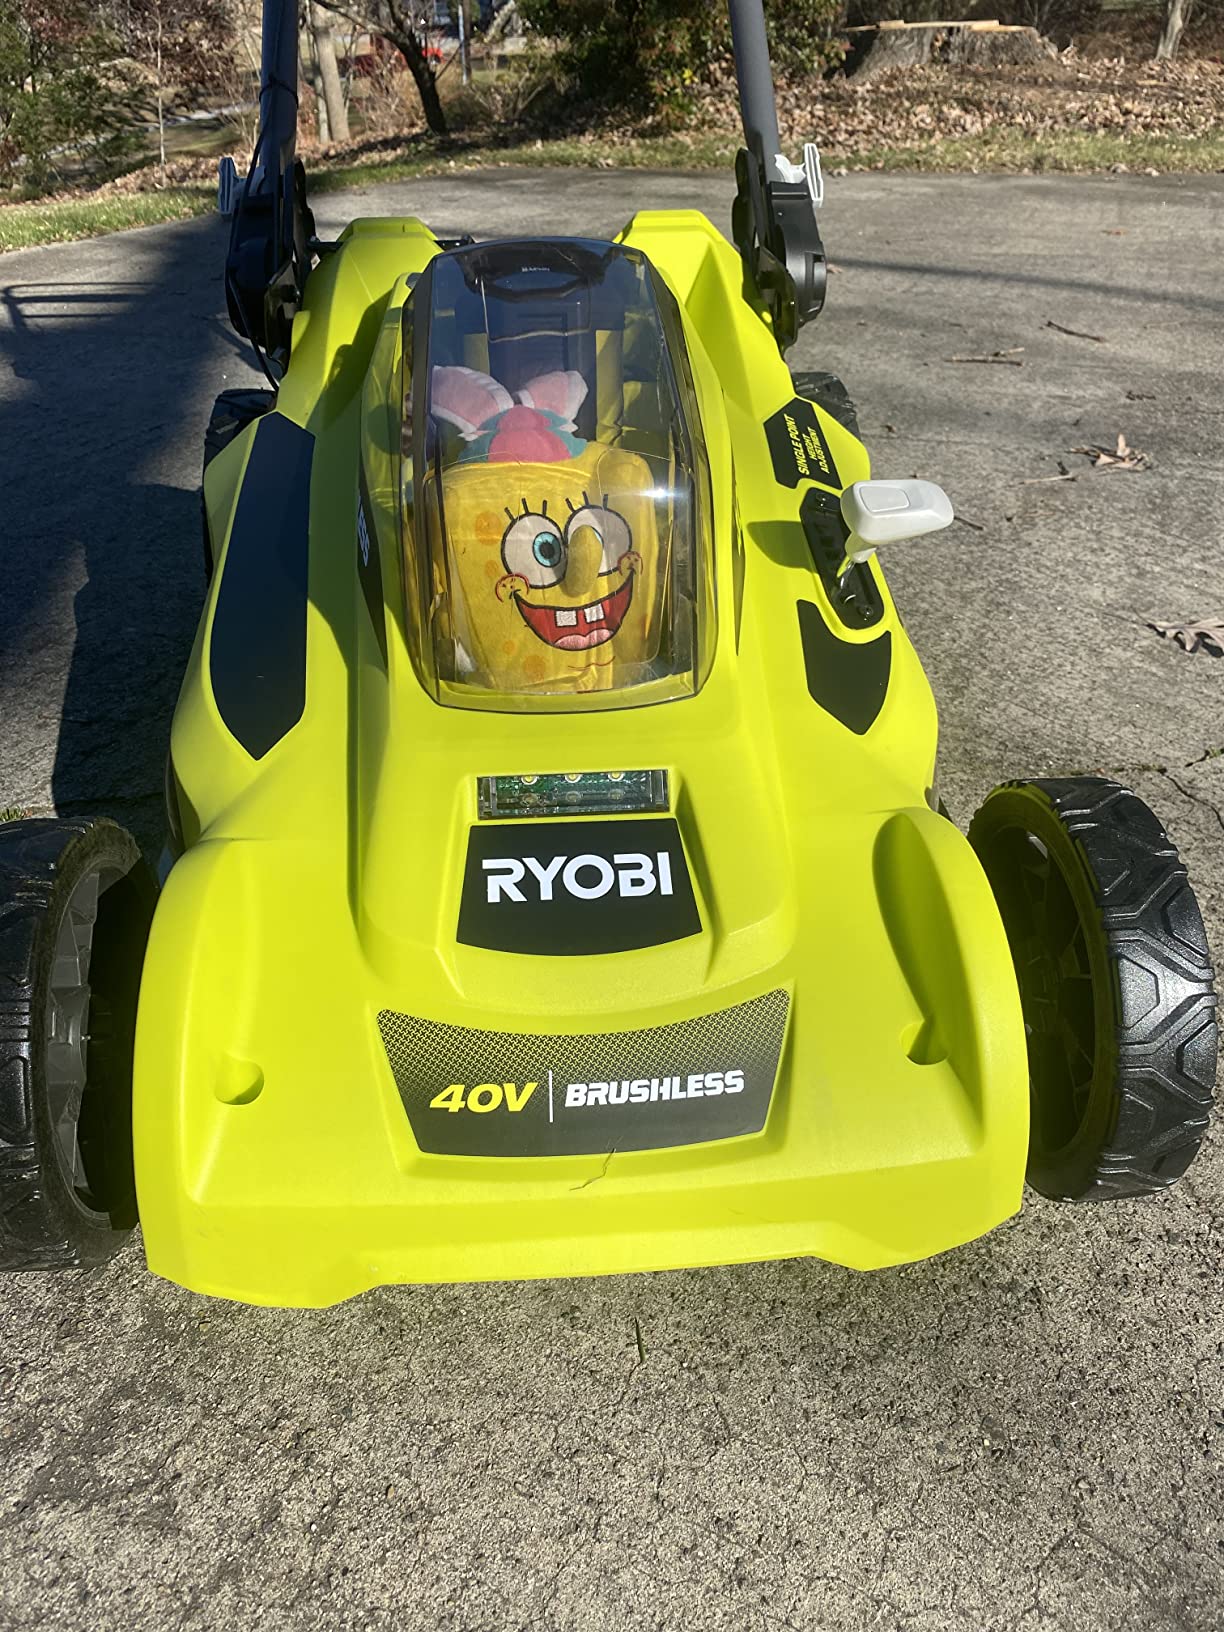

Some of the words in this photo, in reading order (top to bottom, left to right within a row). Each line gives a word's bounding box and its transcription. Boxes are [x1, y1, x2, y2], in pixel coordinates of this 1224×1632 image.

[783, 413, 801, 441] POINT
[802, 433, 818, 460] HEIGHT
[791, 440, 810, 475] SINGLE
[807, 426, 830, 474] ADJUSTMENT
[482, 851, 673, 903] RYOBI
[429, 1082, 539, 1113] 40V
[564, 1069, 745, 1107] BRUSHLESS
